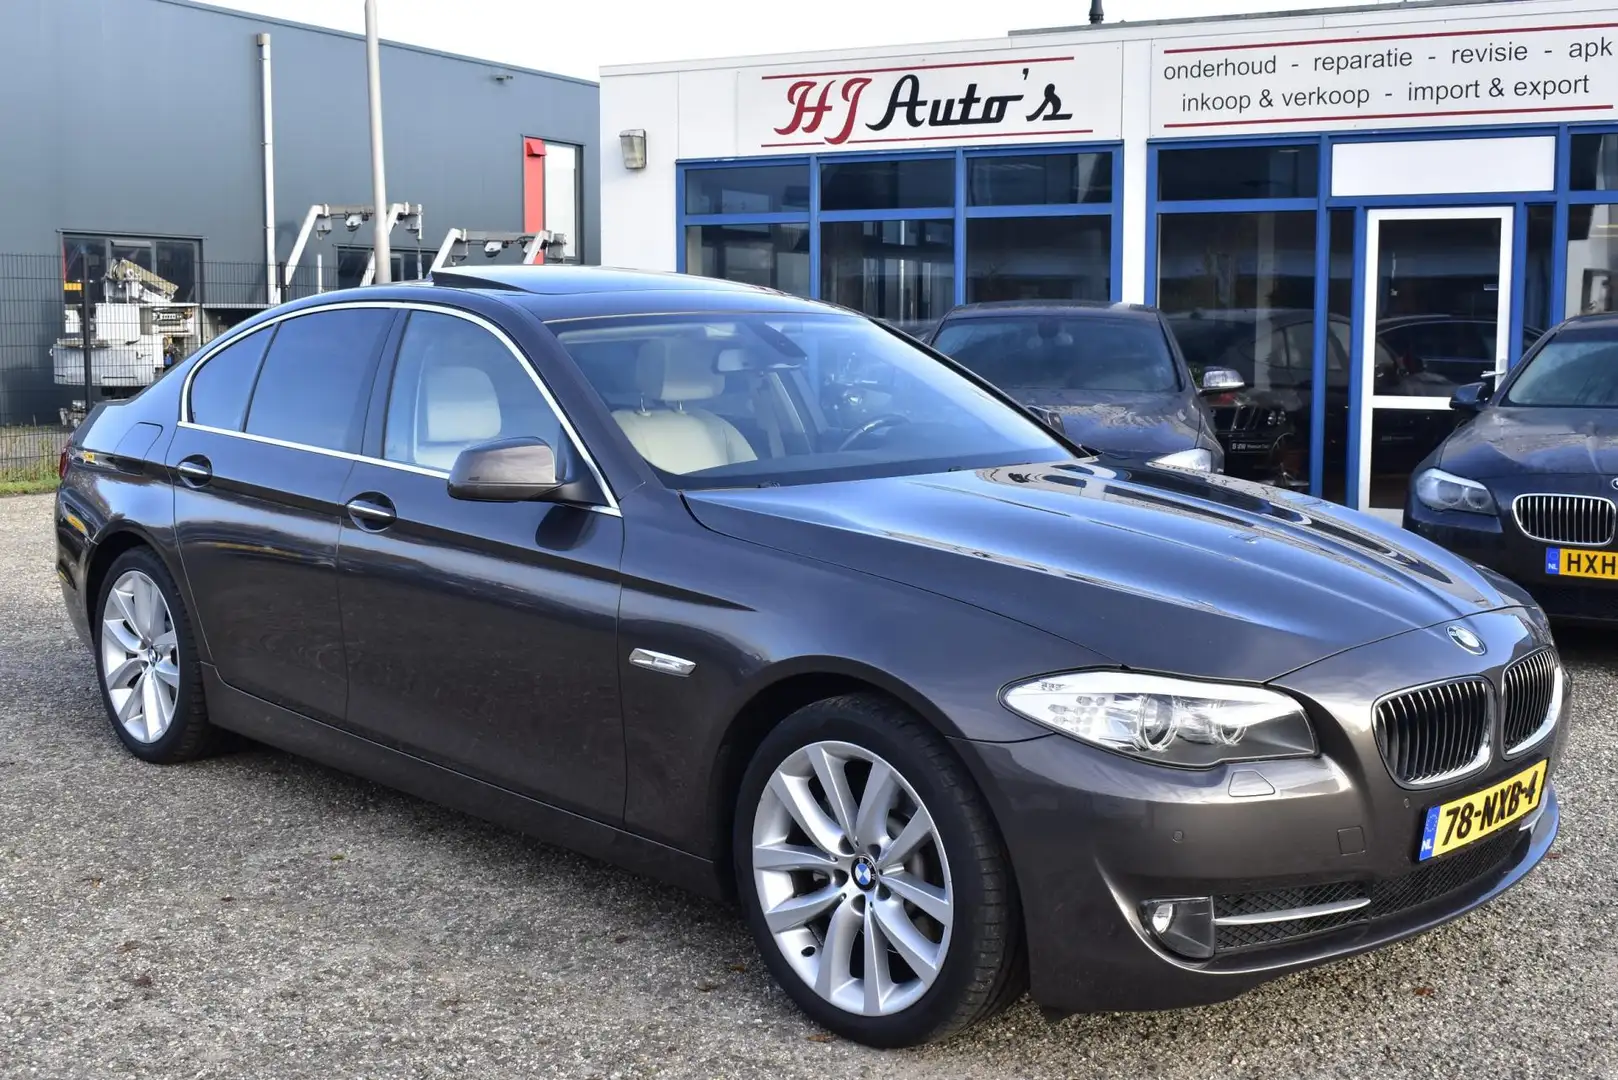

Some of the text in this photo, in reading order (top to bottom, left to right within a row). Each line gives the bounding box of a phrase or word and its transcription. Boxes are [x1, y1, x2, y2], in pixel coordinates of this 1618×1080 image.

[1163, 54, 1277, 81] onderhoud
[1313, 48, 1413, 75] reparatie
[1451, 41, 1529, 64] revisie
[1568, 36, 1614, 62] apk
[773, 68, 1073, 145] HJ Auto's
[1181, 92, 1251, 114] inkoop
[1258, 88, 1274, 108] &
[1281, 86, 1370, 109] verkoop
[1407, 79, 1481, 105] import
[1488, 77, 1505, 98] &
[1513, 74, 1590, 101] export
[1567, 553, 1616, 575] HXH
[1442, 771, 1538, 846] 78-NXB-4
[1421, 839, 1433, 852] NL
